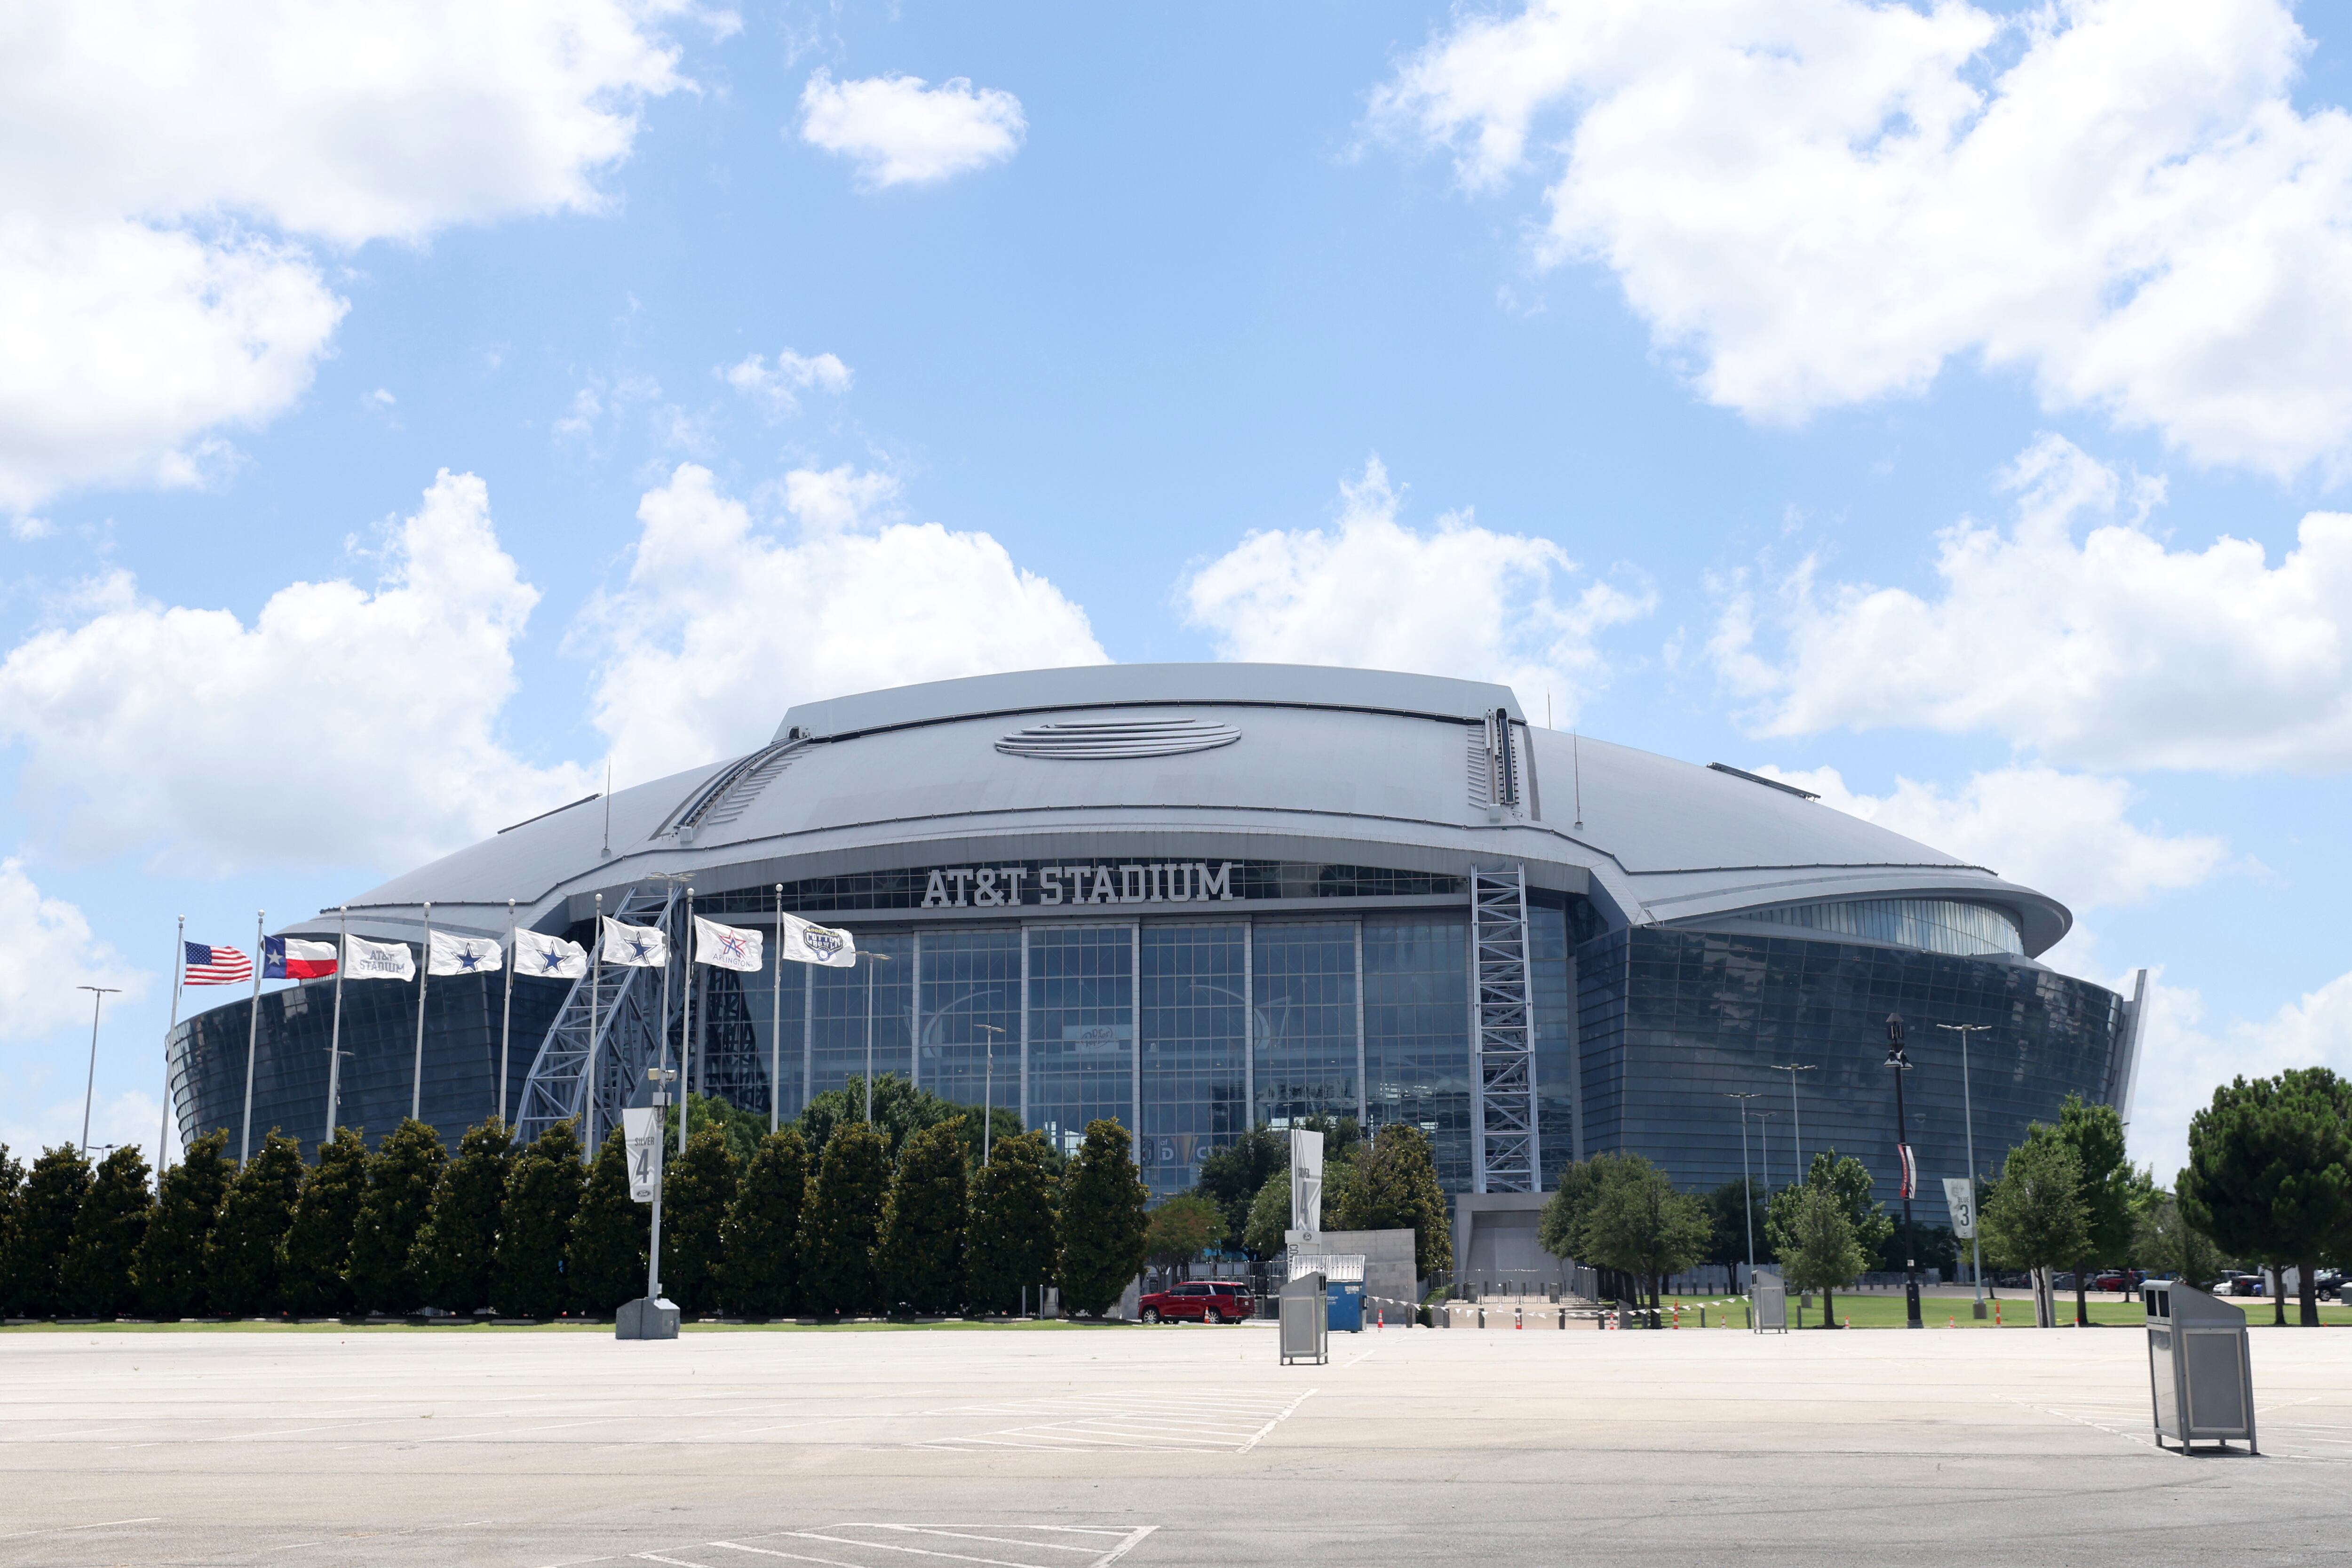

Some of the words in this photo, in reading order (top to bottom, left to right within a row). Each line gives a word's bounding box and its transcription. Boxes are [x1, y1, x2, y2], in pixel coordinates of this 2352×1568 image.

[921, 868, 1027, 907] AT&T
[1040, 862, 1233, 905] STADIUM
[806, 932, 841, 947] COTTON
[812, 940, 834, 949] BOWL
[370, 950, 394, 961] AT&T
[713, 953, 750, 967] ARLINGTON
[360, 959, 405, 973] STADIUM
[1092, 1028, 1103, 1038] Dr
[635, 1136, 655, 1146] SILVER
[636, 1149, 649, 1183] 4
[1298, 1167, 1310, 1178] SILVER
[1300, 1182, 1308, 1224] 4
[1960, 1204, 1969, 1226] 3
